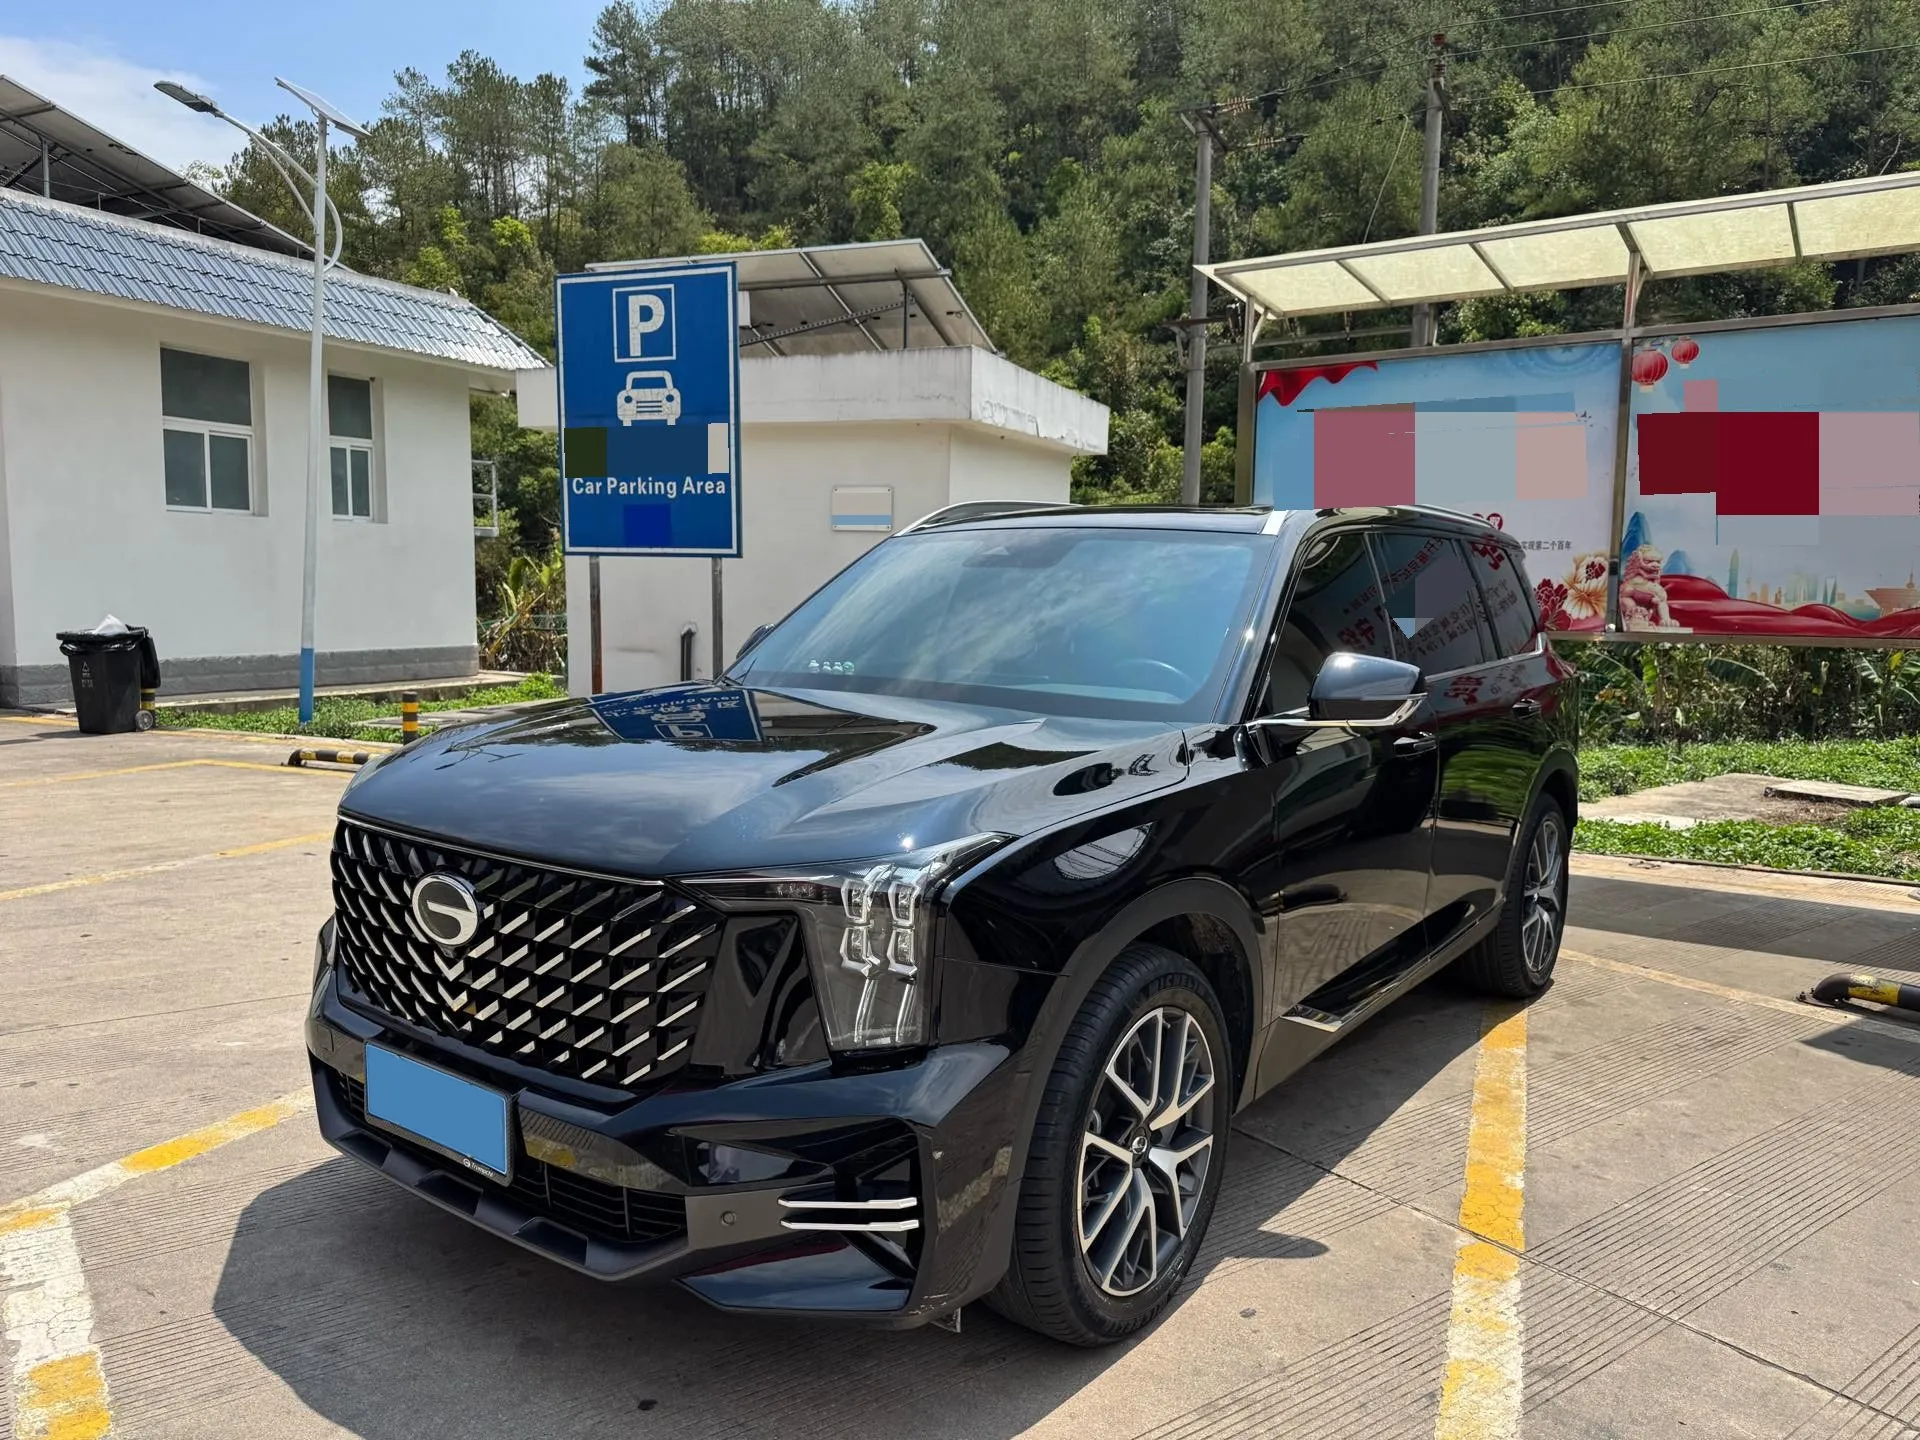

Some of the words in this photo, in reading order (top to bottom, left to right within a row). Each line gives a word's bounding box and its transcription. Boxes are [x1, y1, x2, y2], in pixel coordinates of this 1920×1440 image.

[628, 294, 665, 356] P
[572, 477, 602, 495] Car
[606, 477, 677, 499] Parking
[682, 476, 726, 495] Area
